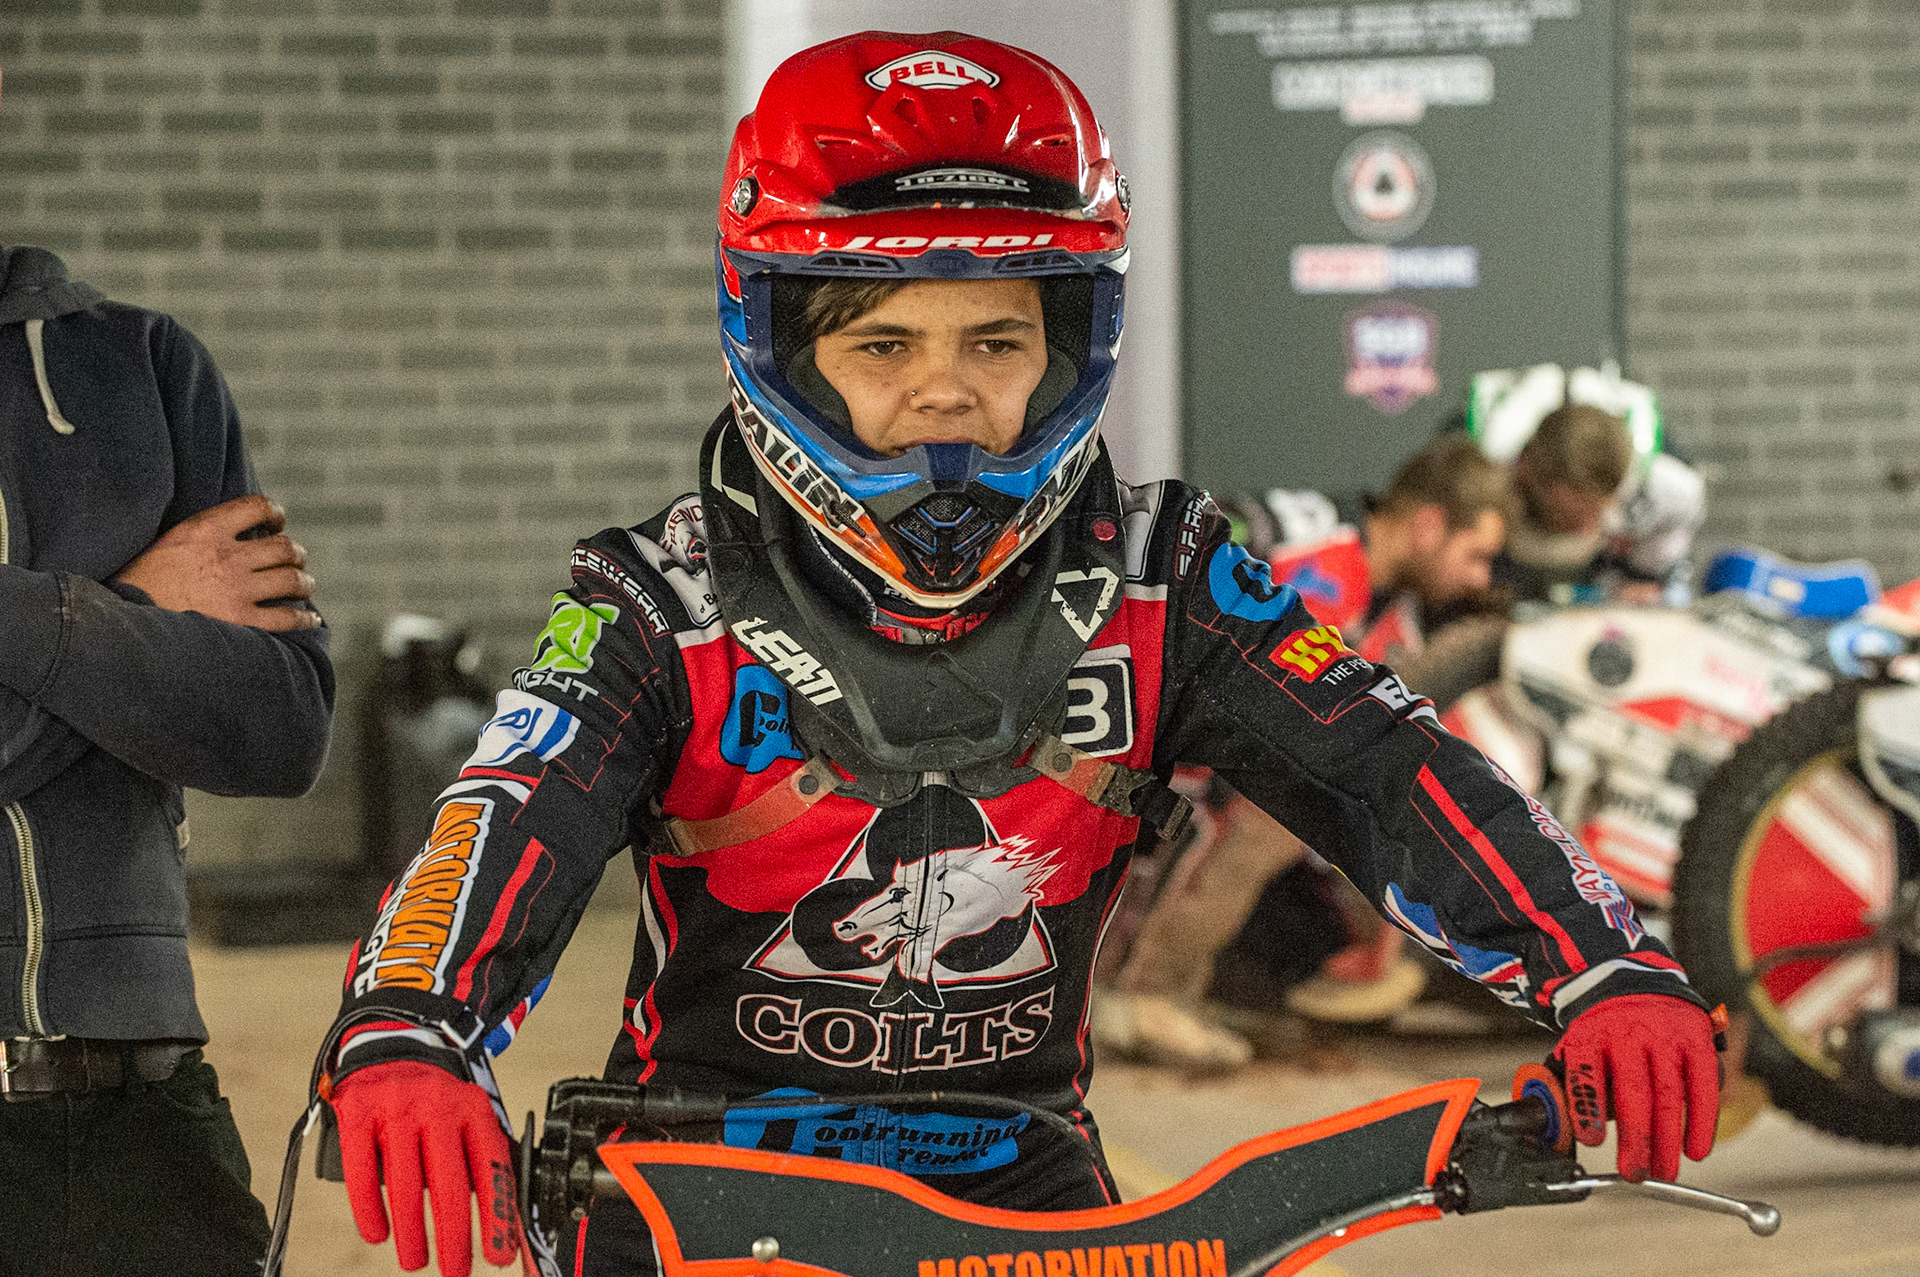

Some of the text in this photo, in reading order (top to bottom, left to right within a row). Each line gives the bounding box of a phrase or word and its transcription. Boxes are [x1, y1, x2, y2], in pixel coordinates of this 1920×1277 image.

[889, 61, 975, 83] BELL
[842, 232, 1055, 250] JORDI
[1321, 663, 1355, 686] THE
[736, 985, 1056, 1075] COLTS
